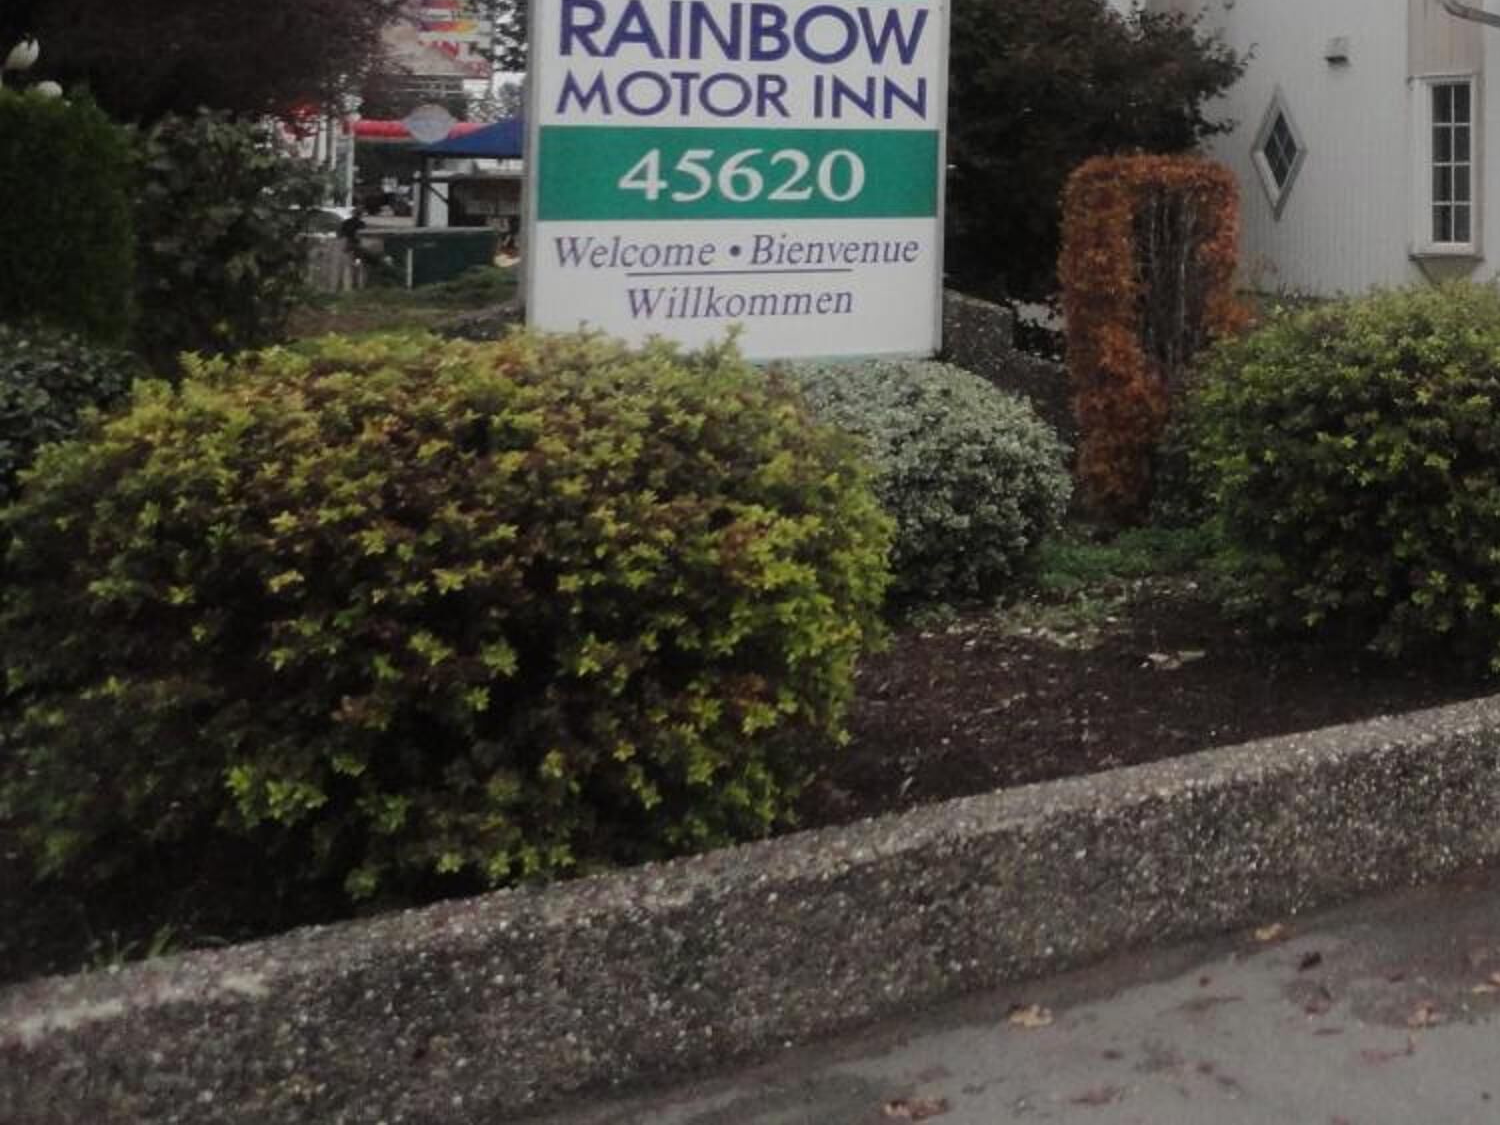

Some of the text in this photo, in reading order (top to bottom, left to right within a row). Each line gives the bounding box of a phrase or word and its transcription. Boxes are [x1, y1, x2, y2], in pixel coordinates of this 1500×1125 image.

[555, 69, 927, 121] MOTOR INN
[617, 147, 866, 203] 45620
[554, 232, 919, 269] Welcome Bienvenue
[626, 287, 854, 320] Willkommen
